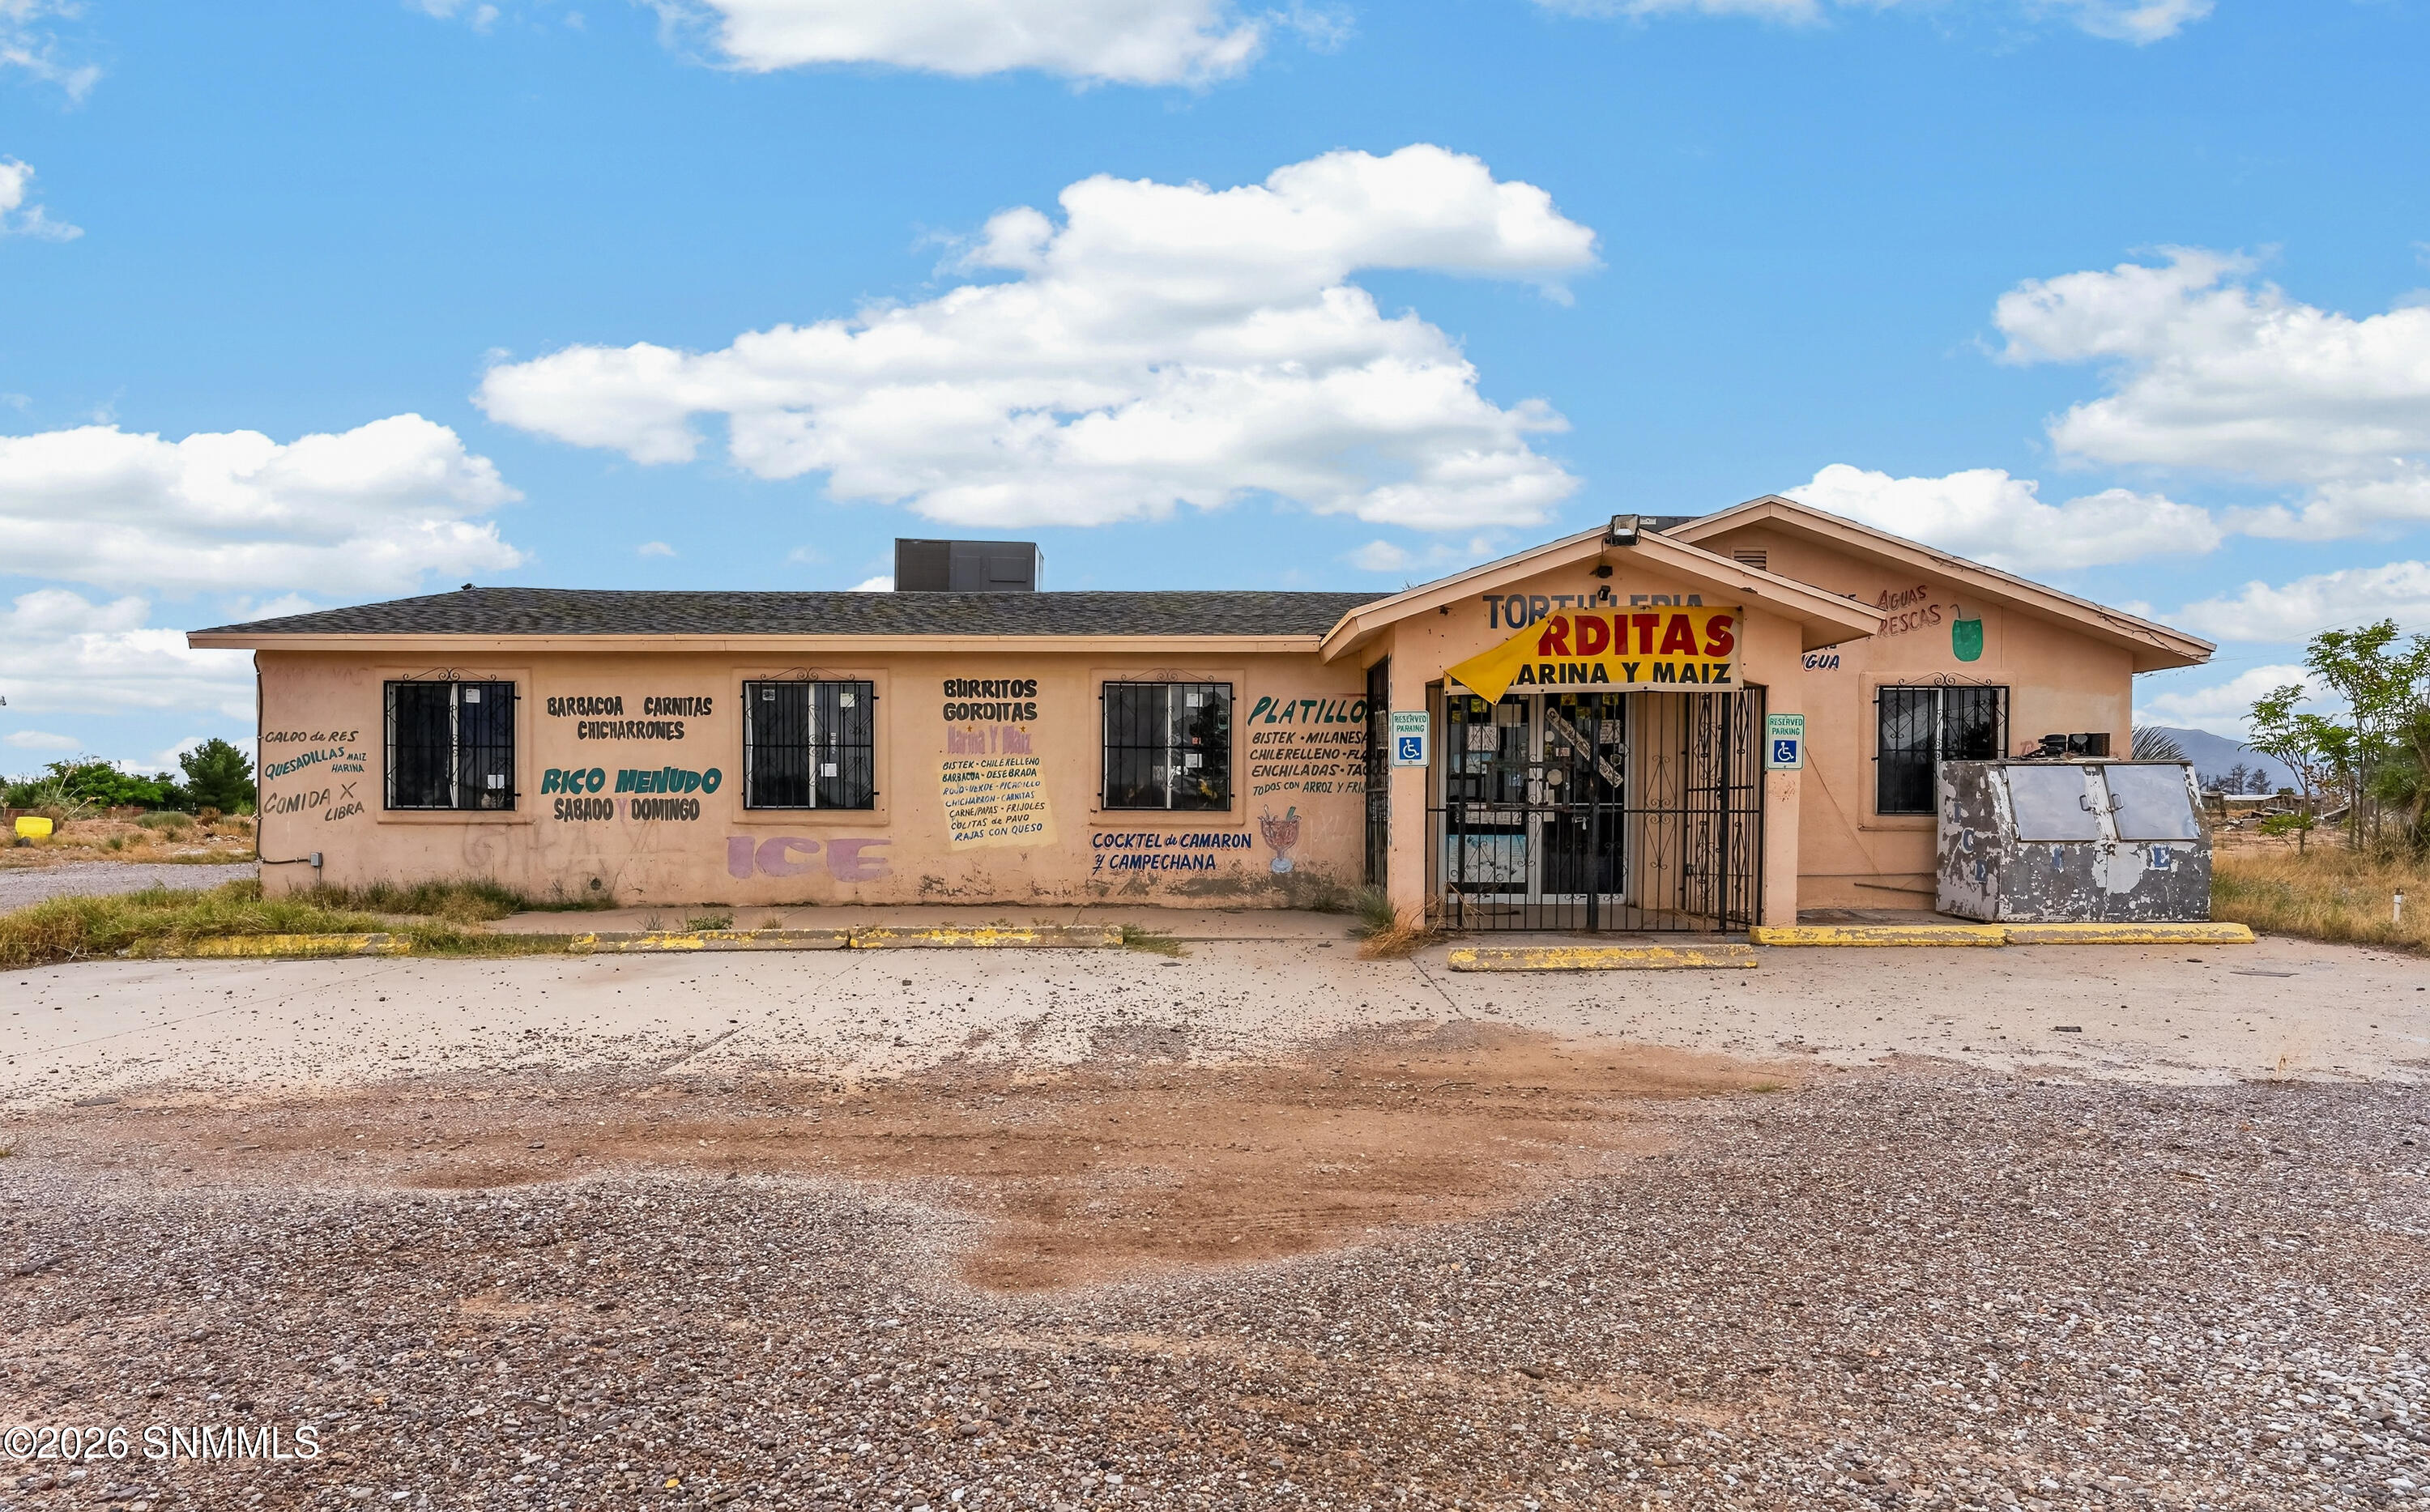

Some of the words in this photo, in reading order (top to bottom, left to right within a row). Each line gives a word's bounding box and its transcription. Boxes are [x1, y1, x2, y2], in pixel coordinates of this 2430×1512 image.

[1876, 586, 1928, 609] AGUAS
[1802, 654, 1840, 671] GUA
[1512, 662, 1610, 685] ARINA
[1621, 662, 1641, 683] Y
[1652, 662, 1731, 684] MAIZ
[944, 679, 1038, 699] BURRITOS
[547, 696, 624, 718] BARBACOA
[644, 696, 713, 717] CARNITAS
[943, 702, 1038, 722] GORDITAS
[1247, 696, 1367, 726] PLATILLO
[1395, 715, 1426, 723] RESERVED
[265, 731, 307, 743] CALDO
[309, 730, 326, 741] de
[328, 730, 359, 743] RES
[577, 720, 685, 741] CHICHARRONES
[1252, 731, 1296, 744] BISTEK
[1396, 725, 1425, 733] PARKING
[989, 725, 998, 754] Y
[265, 747, 345, 781] QUESADILLAS
[347, 752, 367, 761] MAIZ
[331, 764, 364, 773] HARINA
[943, 761, 974, 770] BISTEK
[1251, 764, 1340, 777] ENCHILADAS
[540, 768, 606, 795] RICO
[1253, 782, 1281, 796] TODOS
[1302, 782, 1332, 794] ARROZ
[264, 789, 330, 815] COMIDA
[324, 801, 365, 822] LIBRA
[553, 797, 614, 823] SABADO
[631, 798, 700, 821] DOMINGO
[1006, 803, 1046, 813] FRIJOLES
[951, 818, 988, 830] COLITAS
[991, 817, 1002, 825] de
[1006, 814, 1030, 824] PAVO
[955, 829, 984, 841] RAJAS
[989, 828, 1008, 837] CON
[1012, 823, 1042, 835] QUESO
[1093, 833, 1162, 849] COCKTEL
[1165, 835, 1178, 846] de
[1179, 833, 1251, 849] CAMARON
[727, 835, 892, 882] ICE
[1109, 854, 1216, 870] CAMPECHANA
